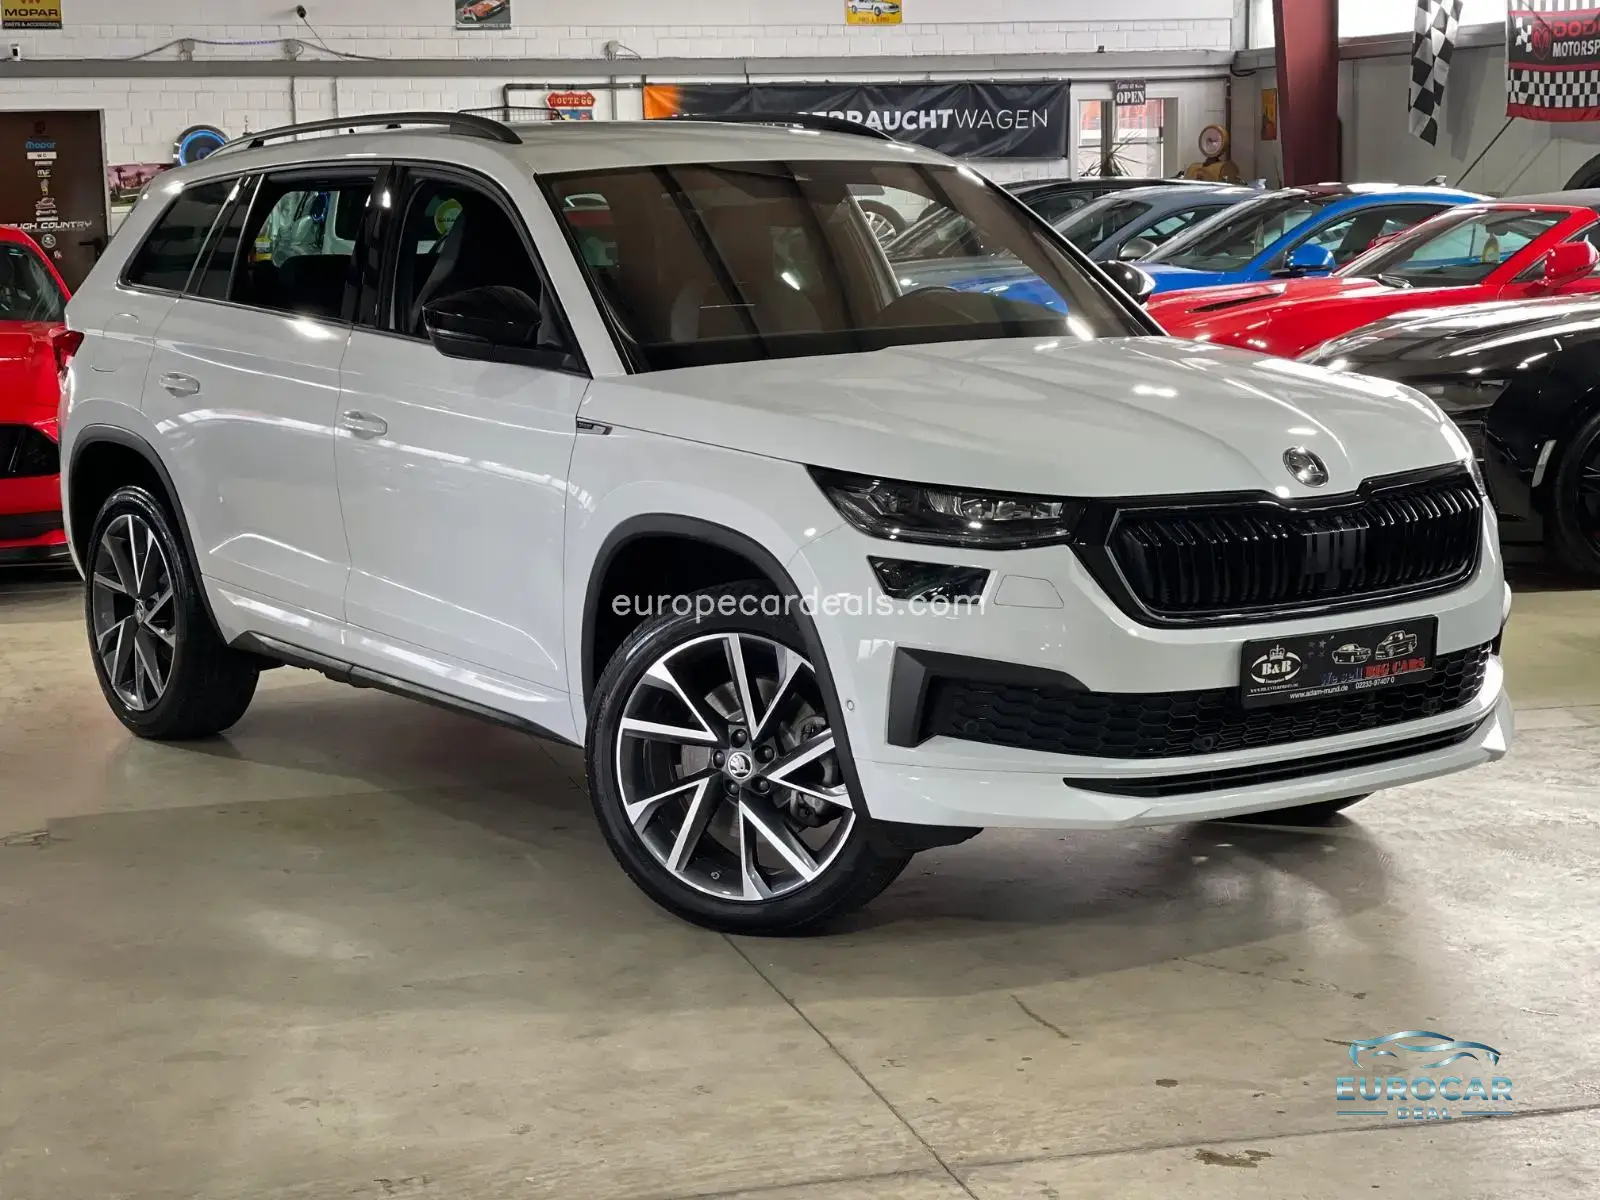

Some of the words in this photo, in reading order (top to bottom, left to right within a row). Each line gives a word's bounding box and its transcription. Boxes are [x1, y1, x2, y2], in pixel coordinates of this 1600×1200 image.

[4, 8, 58, 17] MOPAR
[551, 95, 580, 105] ROUTE
[581, 96, 592, 105] 66
[1116, 90, 1145, 105] OPEN
[41, 219, 93, 230] COUNTRY
[1261, 660, 1292, 676] B&B
[1289, 684, 1349, 700] www.adam-mund.de
